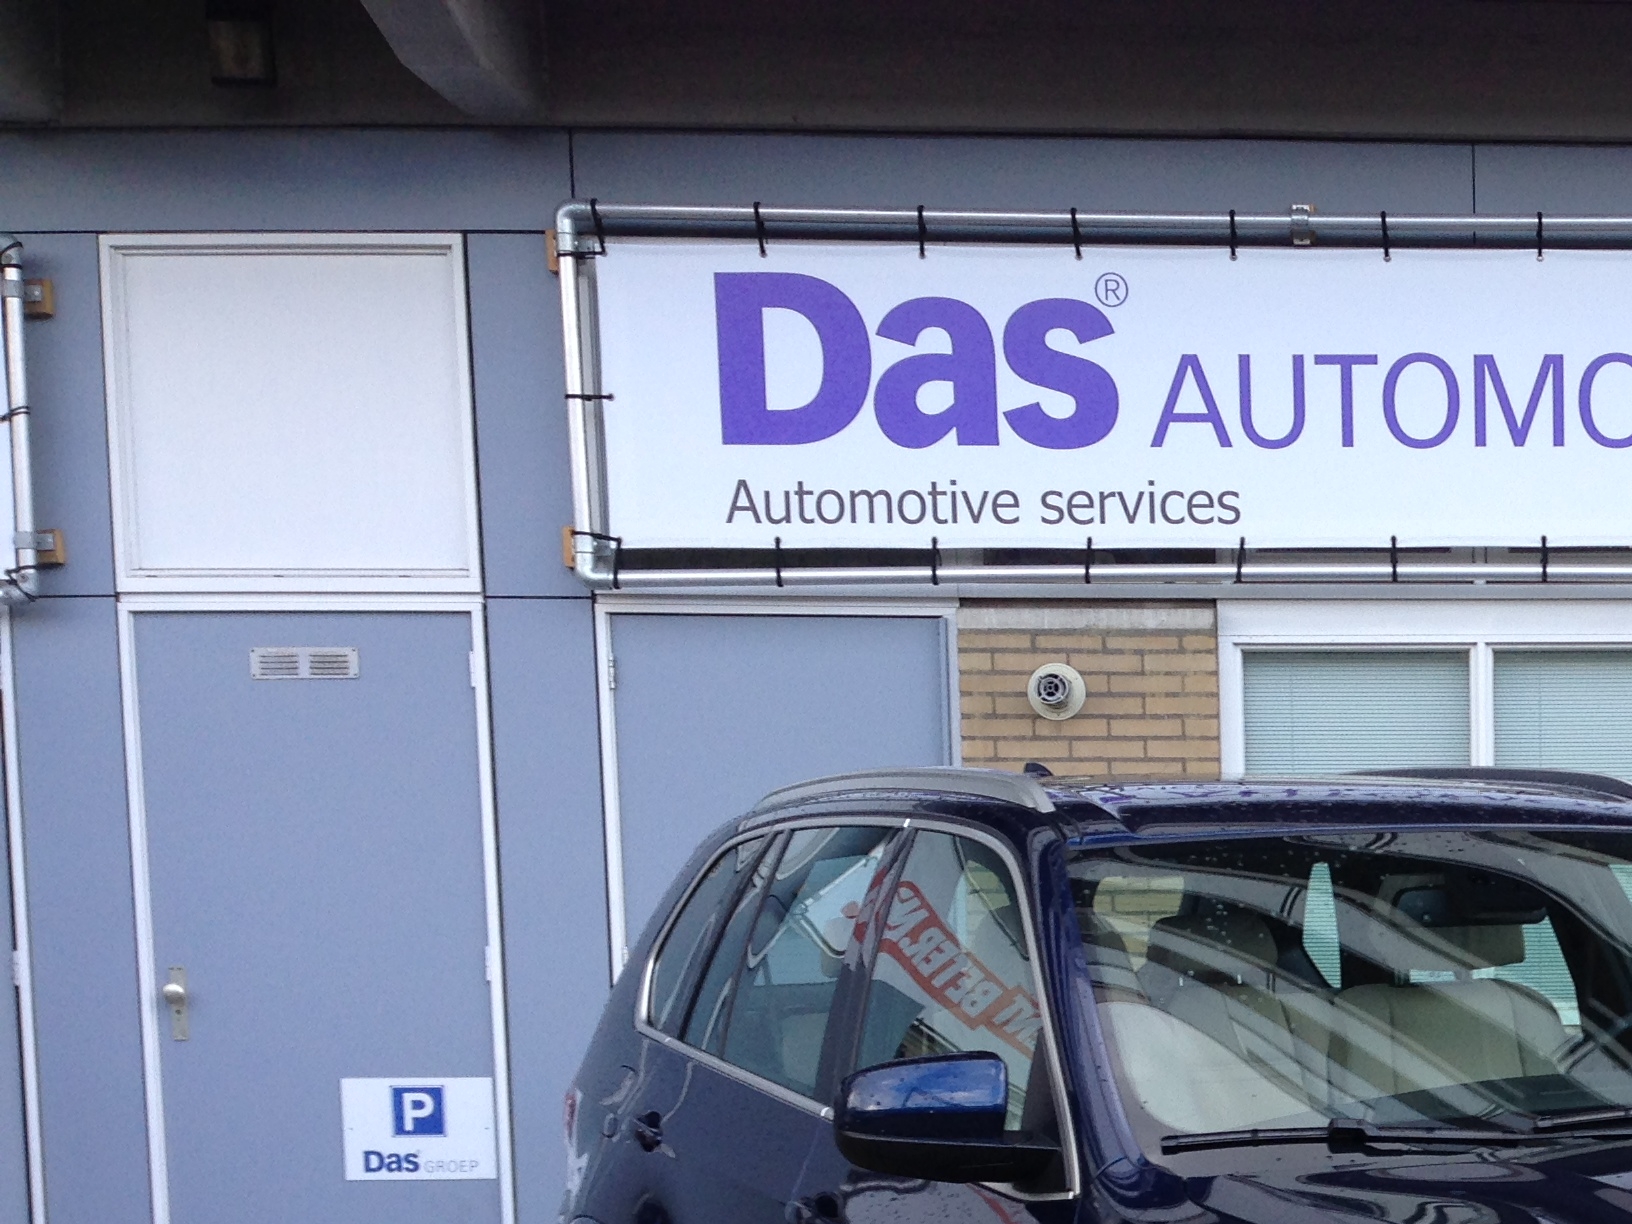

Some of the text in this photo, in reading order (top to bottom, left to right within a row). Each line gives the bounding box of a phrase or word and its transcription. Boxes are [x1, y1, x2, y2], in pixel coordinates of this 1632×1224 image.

[726, 478, 1241, 525] Automotive services
[402, 1092, 434, 1132] P
[363, 1150, 479, 1174] Das GROEP
